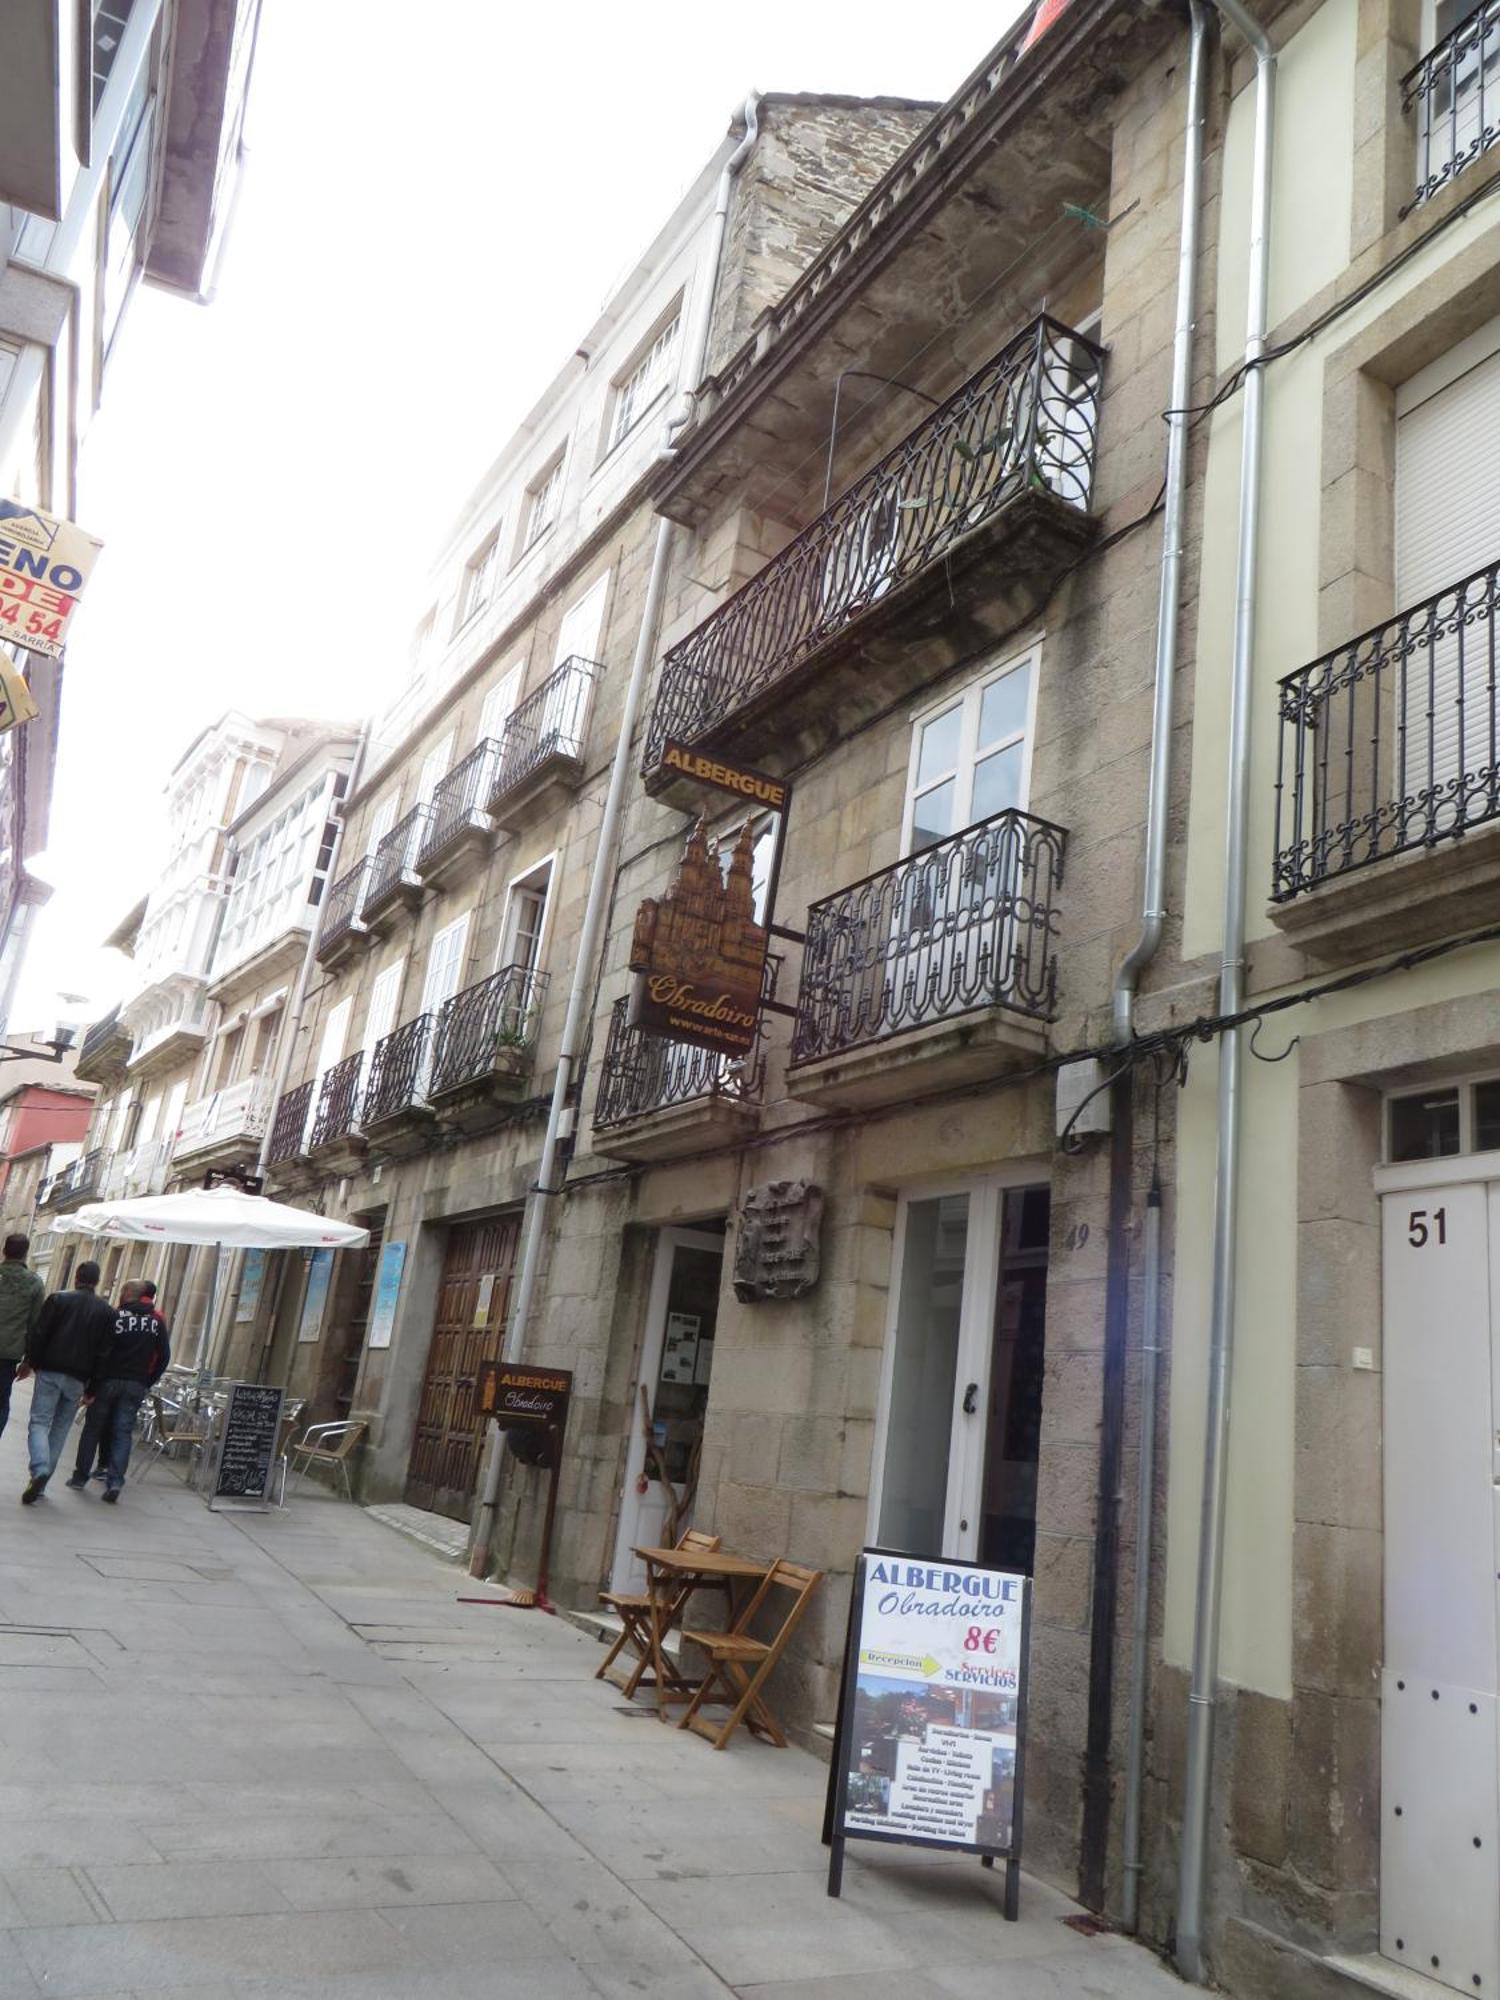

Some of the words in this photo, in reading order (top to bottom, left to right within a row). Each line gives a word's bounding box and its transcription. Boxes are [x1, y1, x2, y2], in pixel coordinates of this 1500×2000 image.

[26, 611, 63, 639] 54
[664, 749, 785, 806] ALBERGUE
[648, 974, 757, 1027] Obradoiro
[1408, 1207, 1446, 1248] 51
[501, 1373, 568, 1392] ALBERGUE
[869, 1561, 1019, 1602] ALBERGUE
[878, 1592, 1006, 1618] Obradoiro
[963, 1625, 1001, 1655] 8€
[944, 1668, 1018, 1690] SERVICIOS
